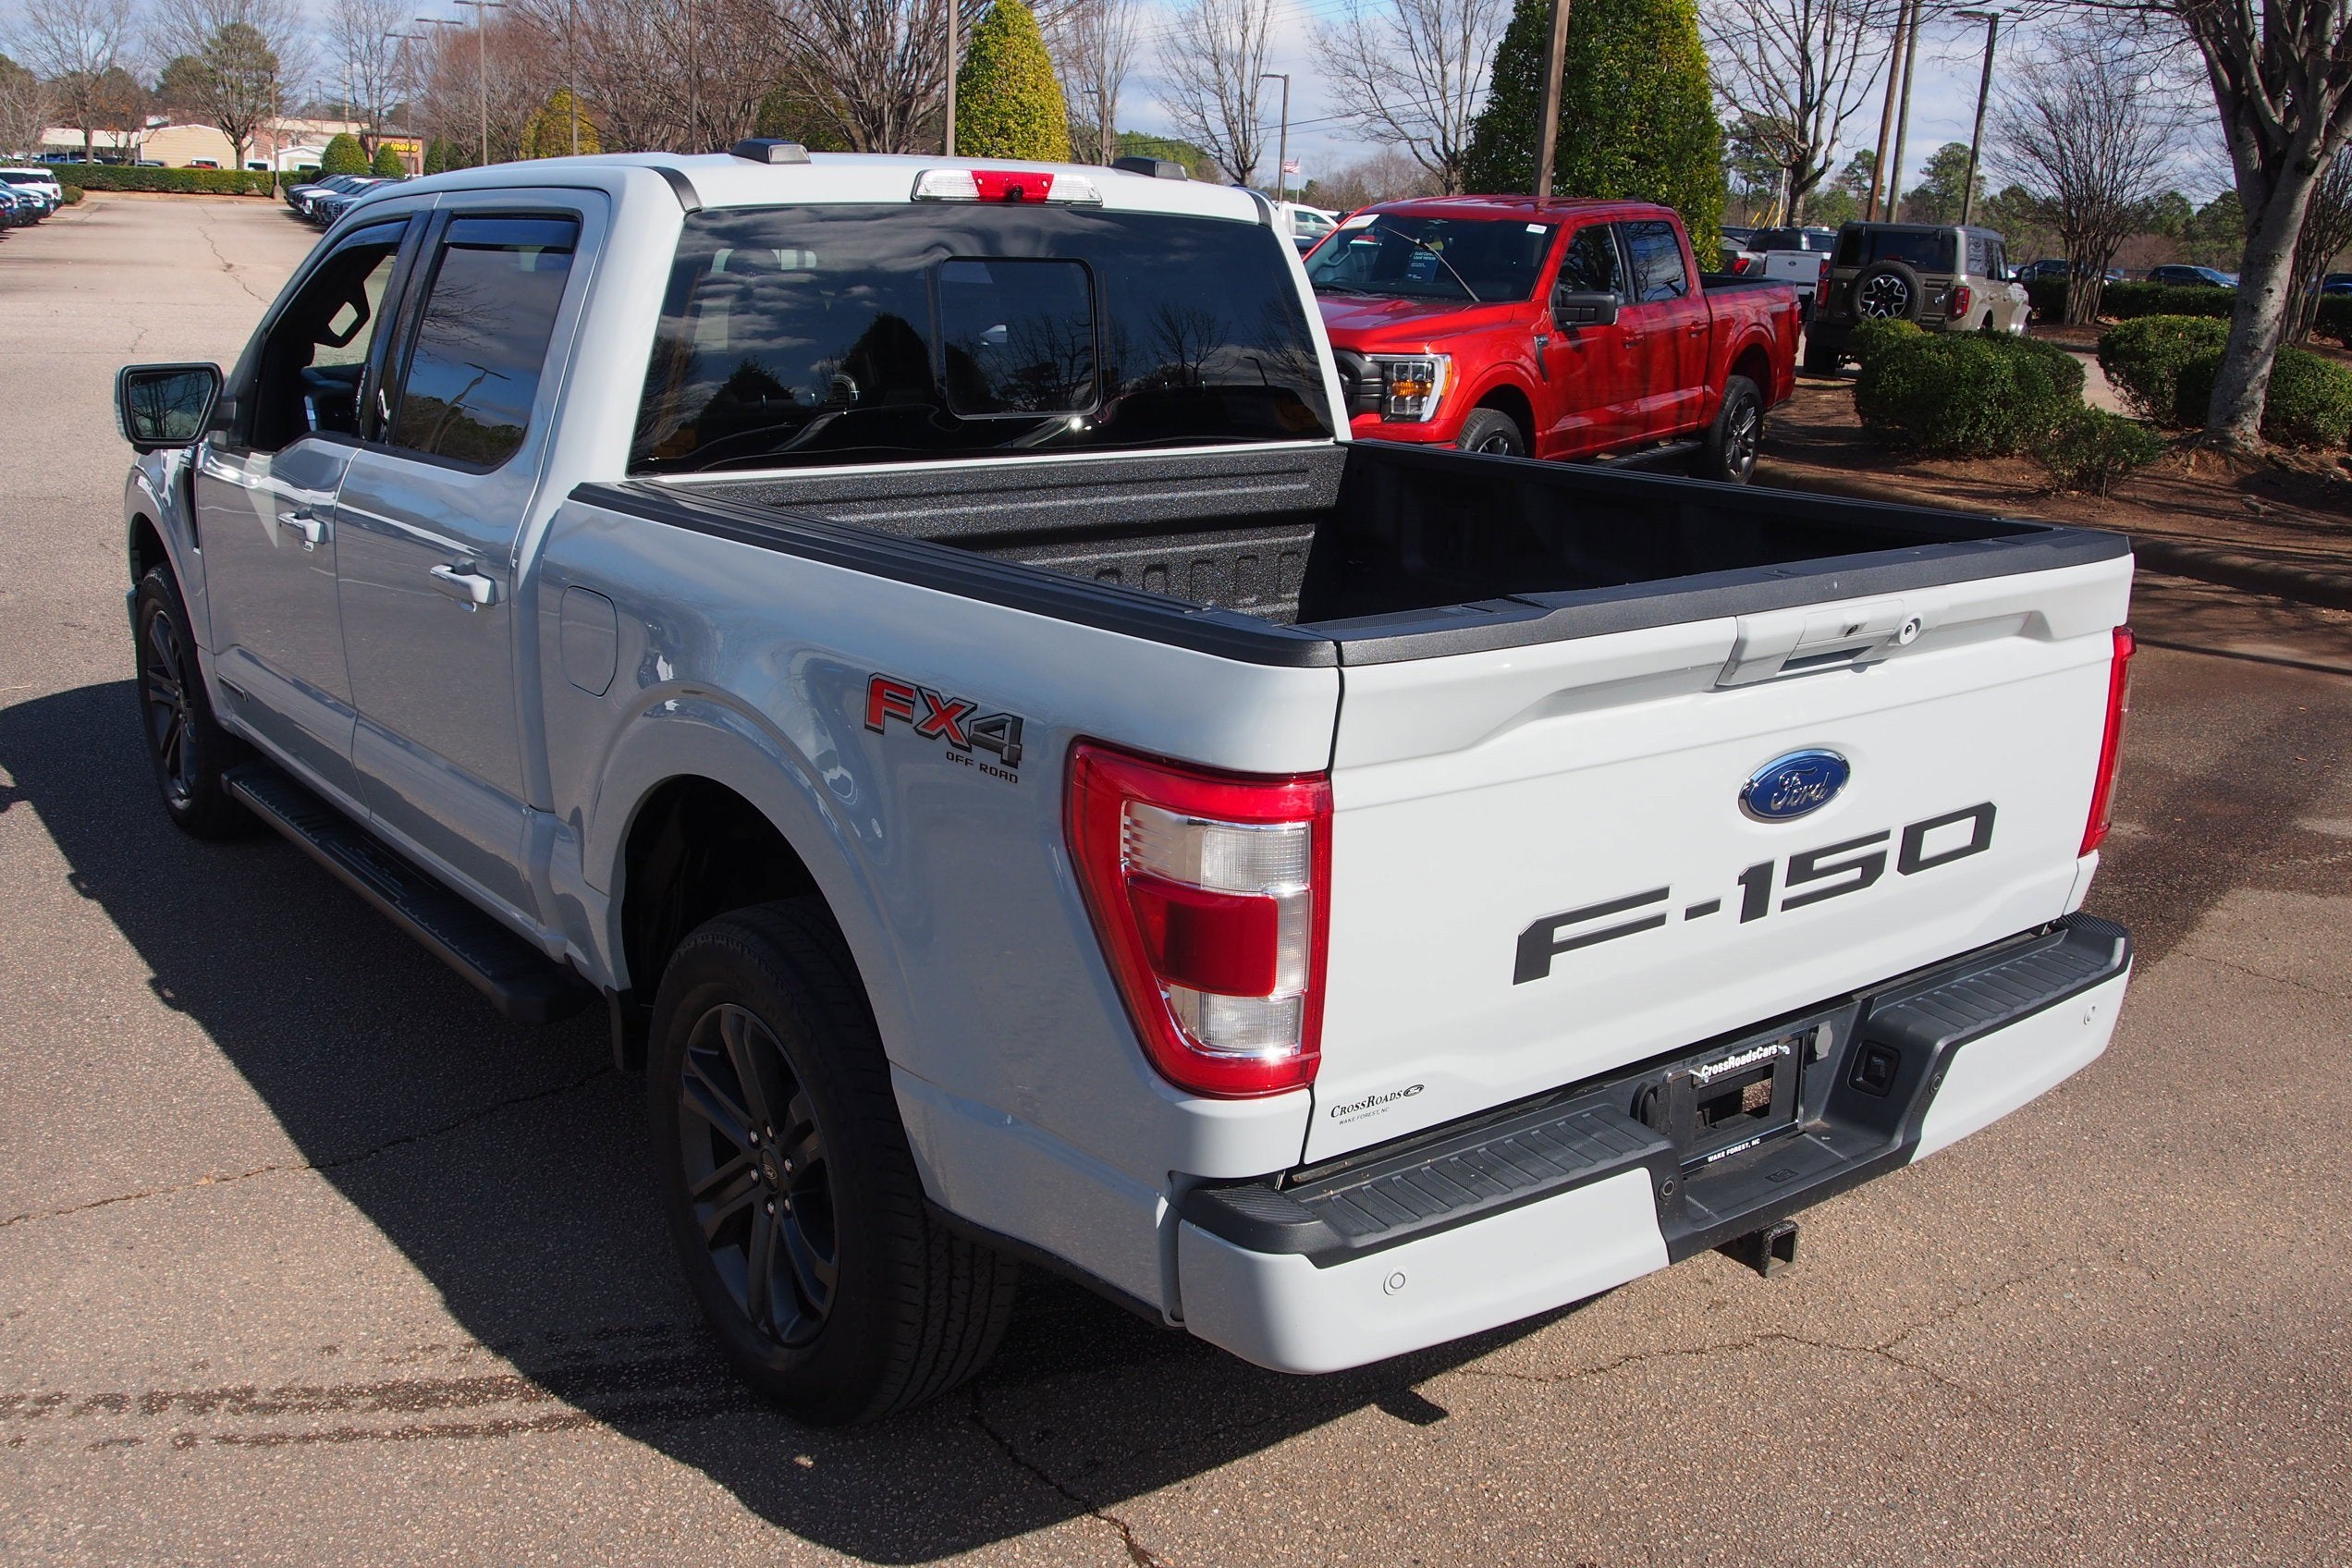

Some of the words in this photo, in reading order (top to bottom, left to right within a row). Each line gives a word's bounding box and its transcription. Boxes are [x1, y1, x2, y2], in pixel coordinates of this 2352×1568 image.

[864, 672, 1025, 769] FX4
[946, 751, 974, 767] OFF
[979, 763, 1019, 784] ROAD
[1770, 766, 1832, 814] Ford
[1513, 801, 1997, 986] F-150
[1700, 1044, 1779, 1078] CrossRoadsCars
[1339, 1116, 1355, 1125] WAKE
[1708, 1150, 1726, 1163] WAKE
[1726, 1143, 1751, 1157] FOREST,
[1751, 1138, 1761, 1146] NC
